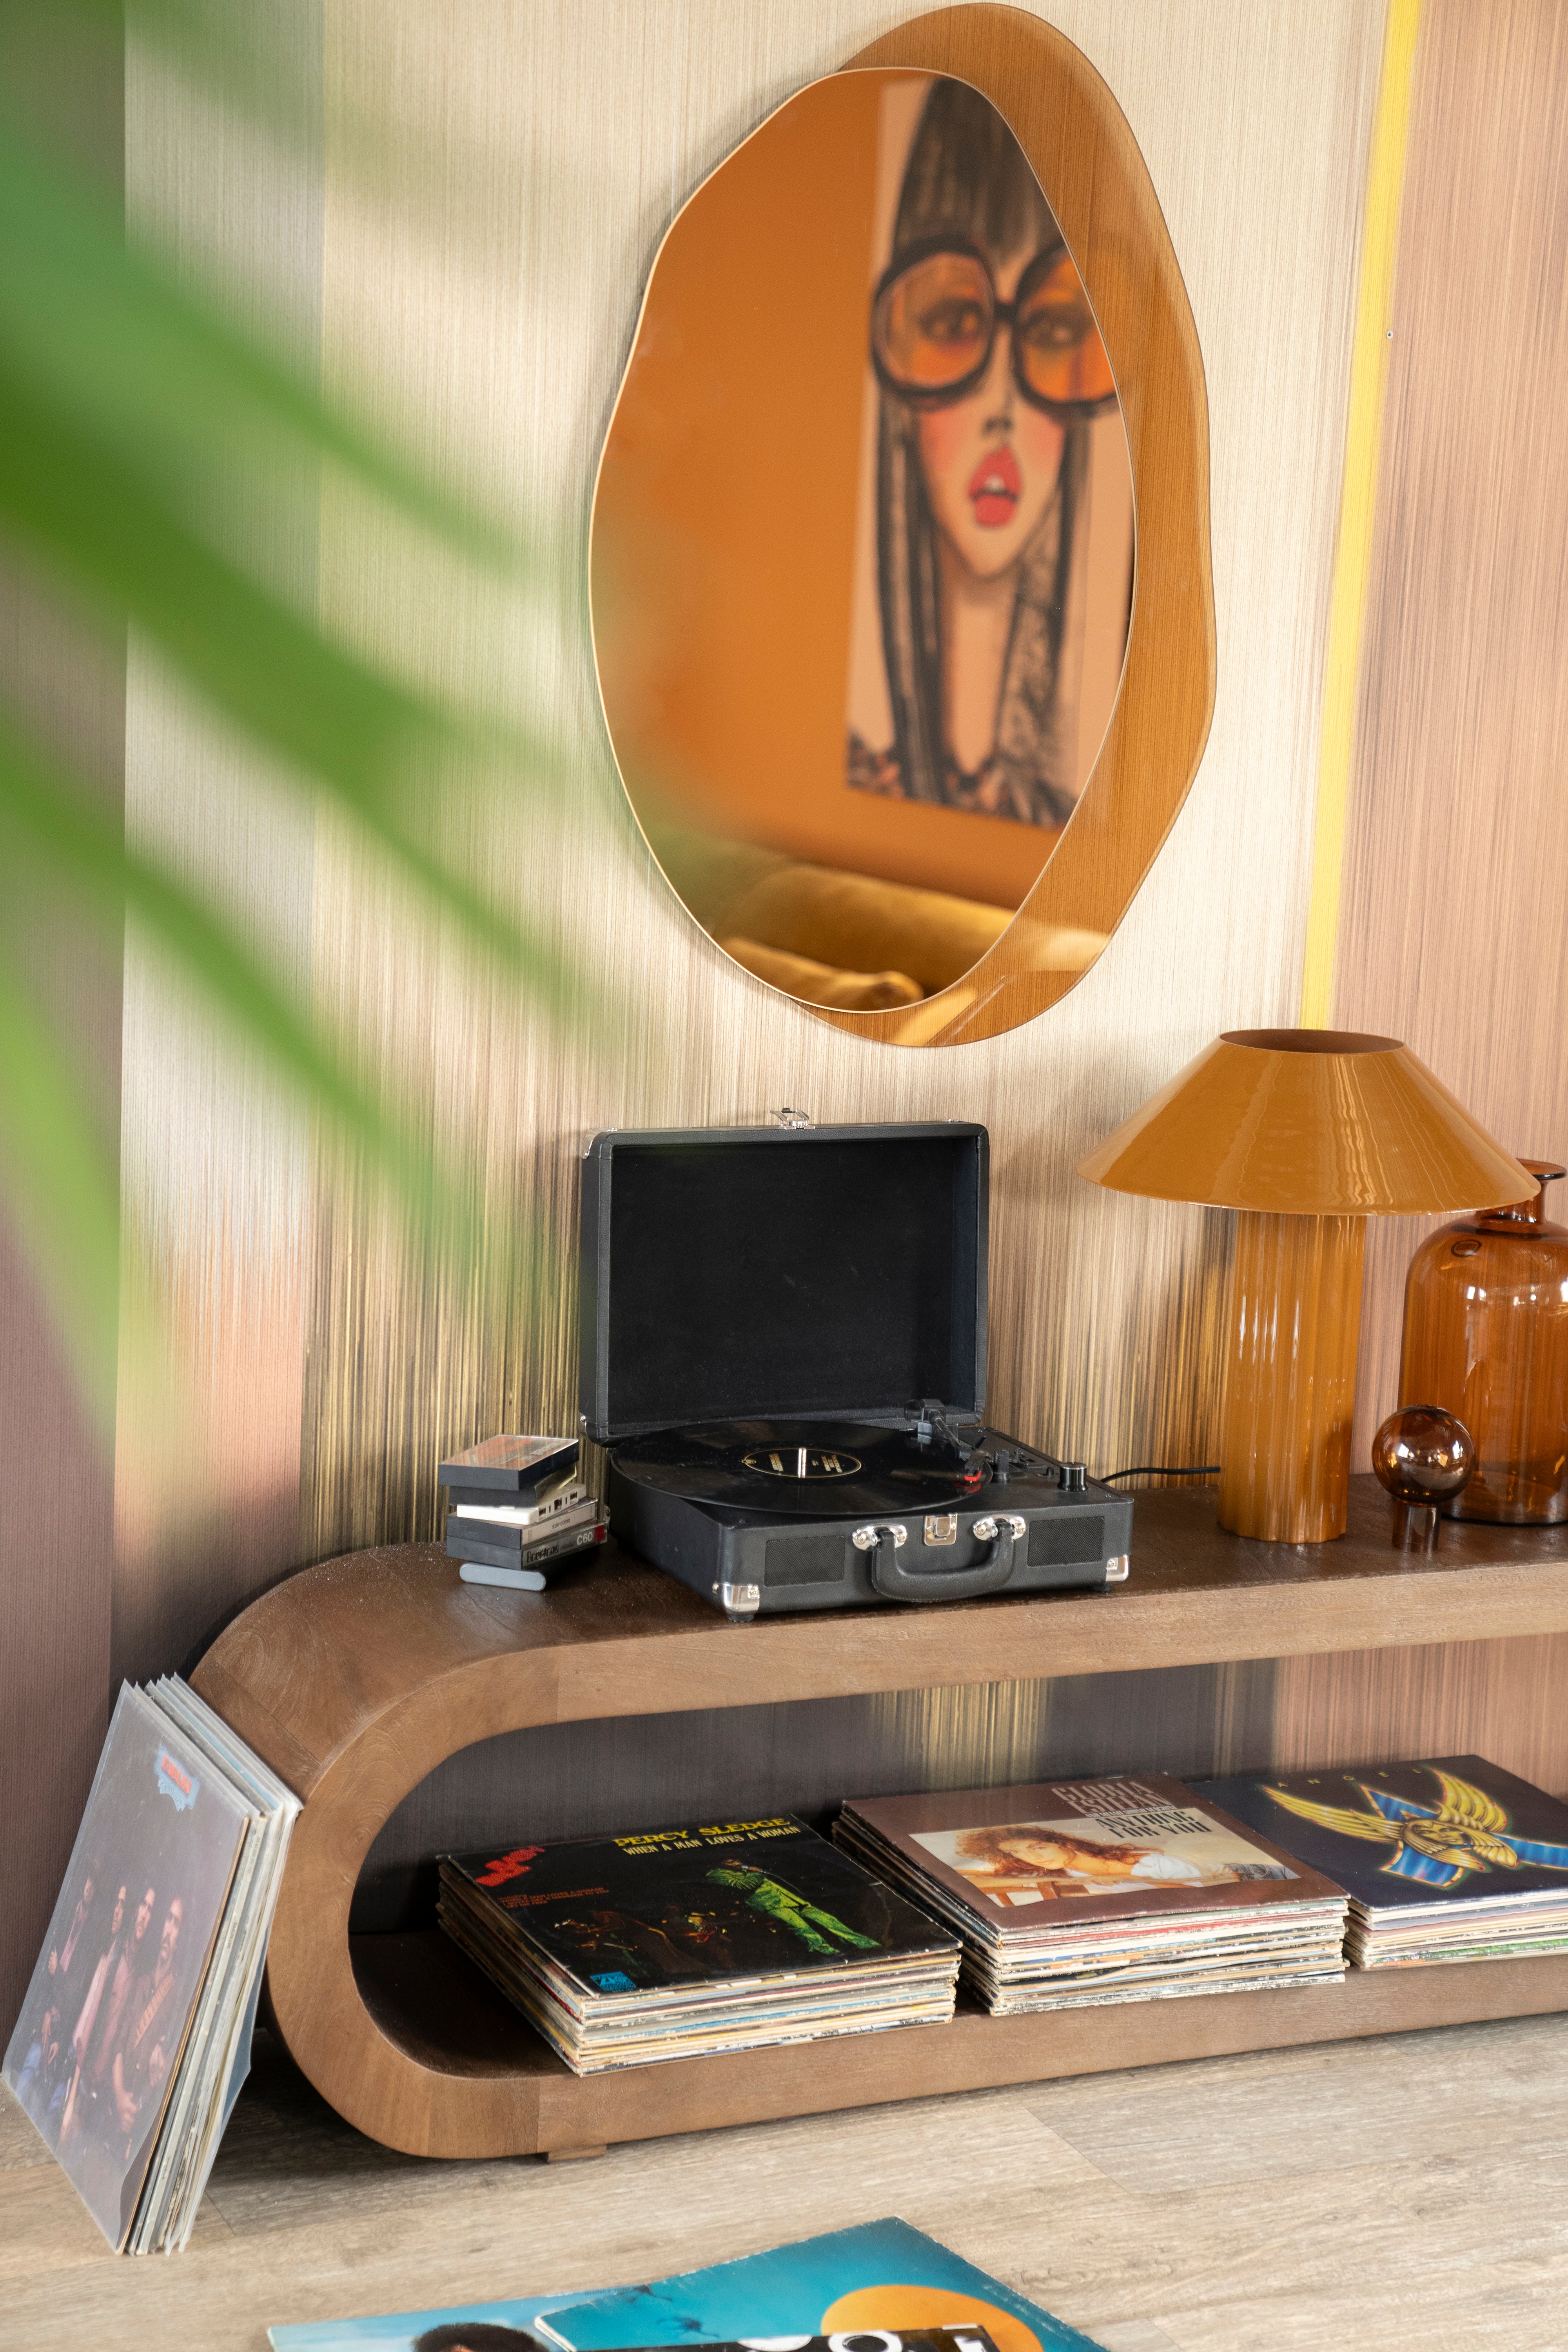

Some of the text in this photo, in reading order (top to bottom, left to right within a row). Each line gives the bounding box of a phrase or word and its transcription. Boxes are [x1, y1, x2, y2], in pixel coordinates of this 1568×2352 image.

[552, 1518, 571, 1529] DISCO-HITS
[577, 1532, 593, 1546] C60
[1051, 1781, 1154, 1801] GLORIA
[1067, 1793, 1172, 1814] ESTEFAN
[1095, 1811, 1196, 1829] ANYTHING
[1109, 1821, 1212, 1838] FOR YOU
[613, 1818, 790, 1846] PERCY SLEDGE
[623, 1844, 659, 1855] WHEN
[676, 1839, 703, 1849] MAN
[706, 1835, 745, 1845] LOVES
[748, 1832, 758, 1840] A
[757, 1826, 801, 1838] WOMAN
